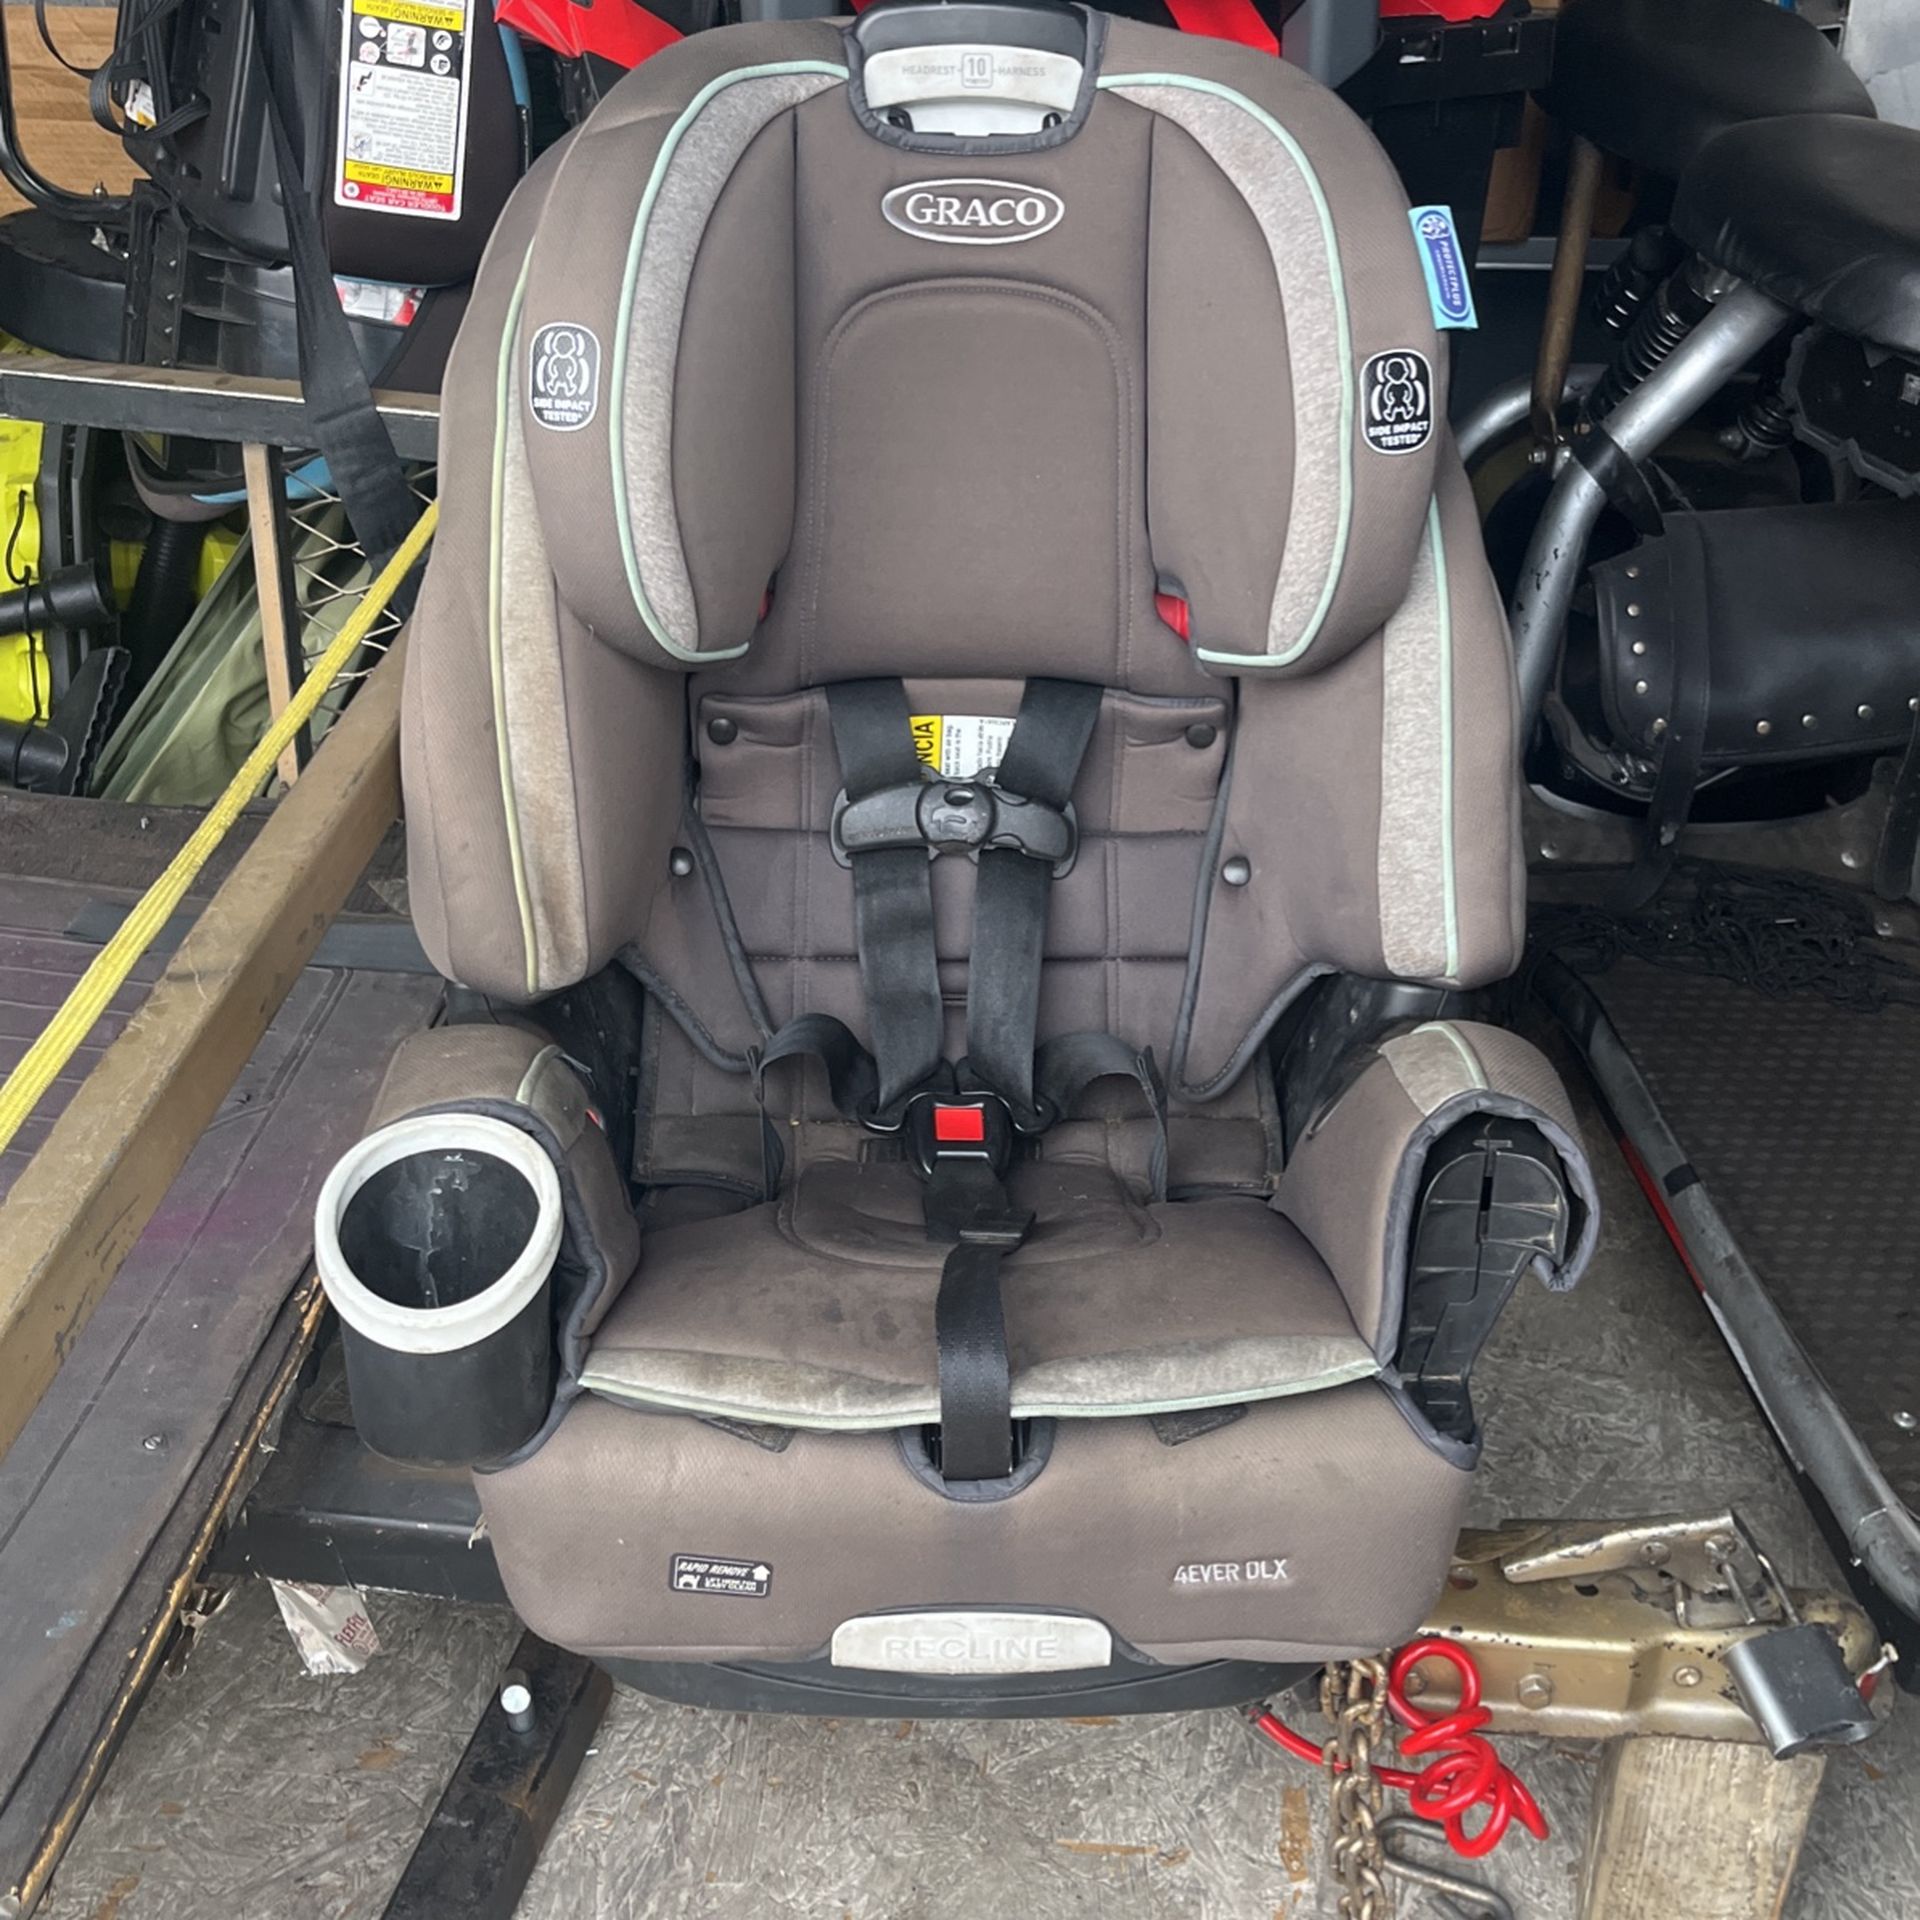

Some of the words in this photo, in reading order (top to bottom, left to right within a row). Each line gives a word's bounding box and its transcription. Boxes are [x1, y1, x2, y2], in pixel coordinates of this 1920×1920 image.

[392, 8, 444, 25] WARNING!
[902, 65, 957, 76] HEADREST
[968, 57, 986, 75] 10
[998, 66, 1046, 77] HARNESS
[382, 175, 435, 190] WARNING!
[363, 194, 386, 204] SEAT
[386, 197, 408, 207] CAR
[905, 193, 1047, 227] GRACO
[534, 397, 553, 409] SIDE
[554, 399, 591, 412] IMPACT
[1368, 425, 1392, 437] SIDE
[1393, 421, 1429, 434] IMPACT
[678, 1562, 709, 1573] RAPID
[709, 1564, 751, 1576] REMOVE
[1173, 1563, 1239, 1585] 4EVER
[1246, 1559, 1287, 1580] DLX
[885, 1636, 1060, 1660] RECLINE
